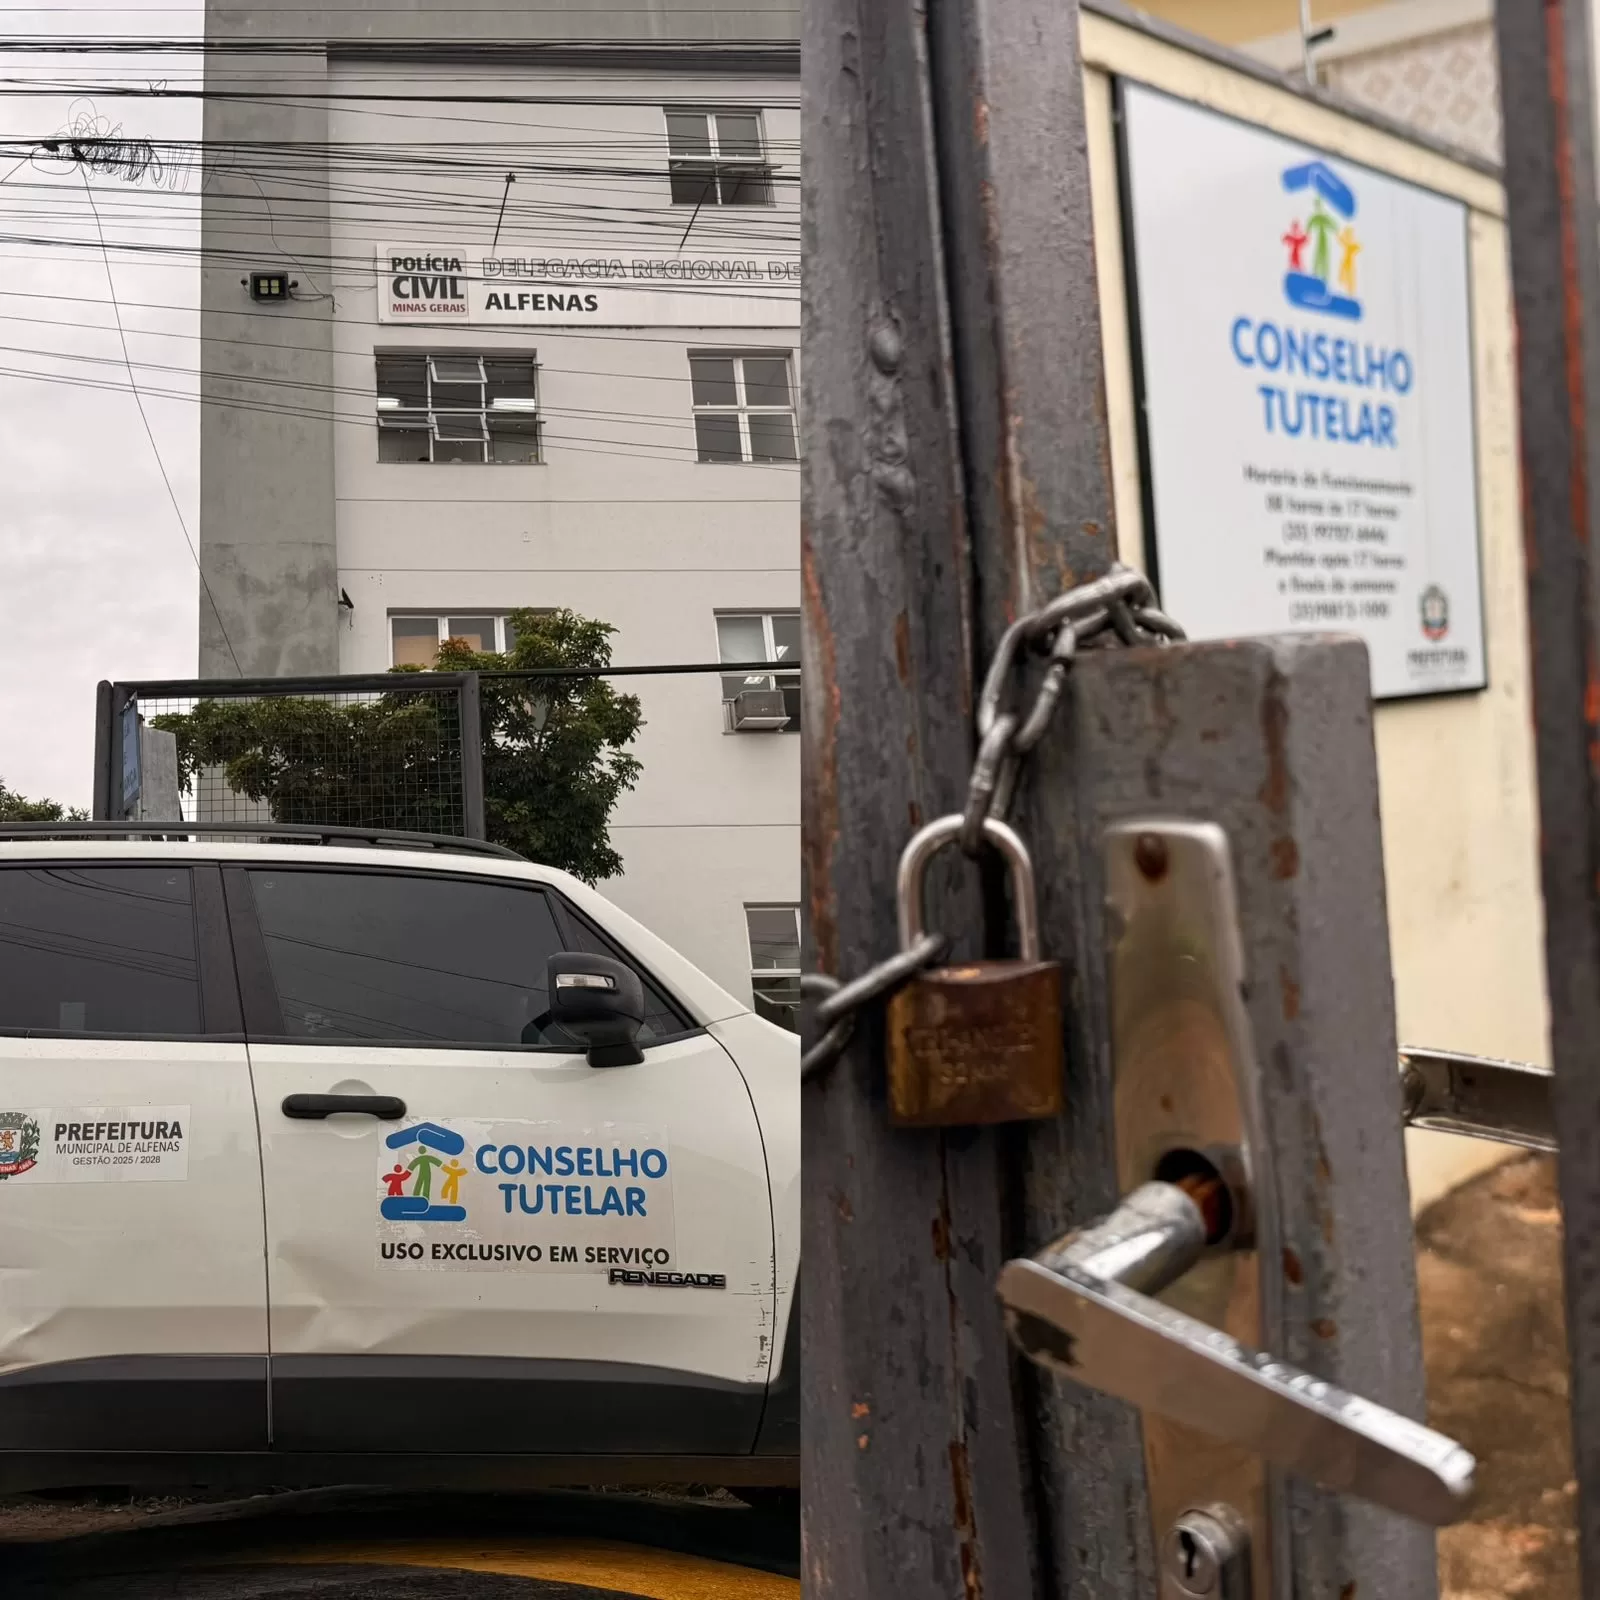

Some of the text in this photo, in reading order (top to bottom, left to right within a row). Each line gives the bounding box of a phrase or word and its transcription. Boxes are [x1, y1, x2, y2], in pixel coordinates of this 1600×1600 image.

[391, 253, 462, 272] POLÍCIA
[483, 257, 800, 281] DELEGACIA REGIONAL DE
[392, 276, 464, 299] CIVIL
[392, 303, 466, 313] MINAS GERAIS
[485, 293, 598, 312] ALFENAS
[1230, 316, 1413, 394] CONSELHO
[1257, 383, 1398, 449] TUTELAR
[54, 1121, 183, 1141] PREFEITURA
[56, 1141, 180, 1155] MUNICIPAL DE ALFENAS
[72, 1156, 111, 1166] GESTÃO
[113, 1156, 134, 1165] 2025
[140, 1155, 161, 1164] 2028
[475, 1144, 668, 1179] CONSELHO
[498, 1183, 647, 1217] TUTELAR
[381, 1243, 670, 1268] USO EXCLUSIVO EM SERVIÇO
[608, 1268, 726, 1290] RENEGADE
